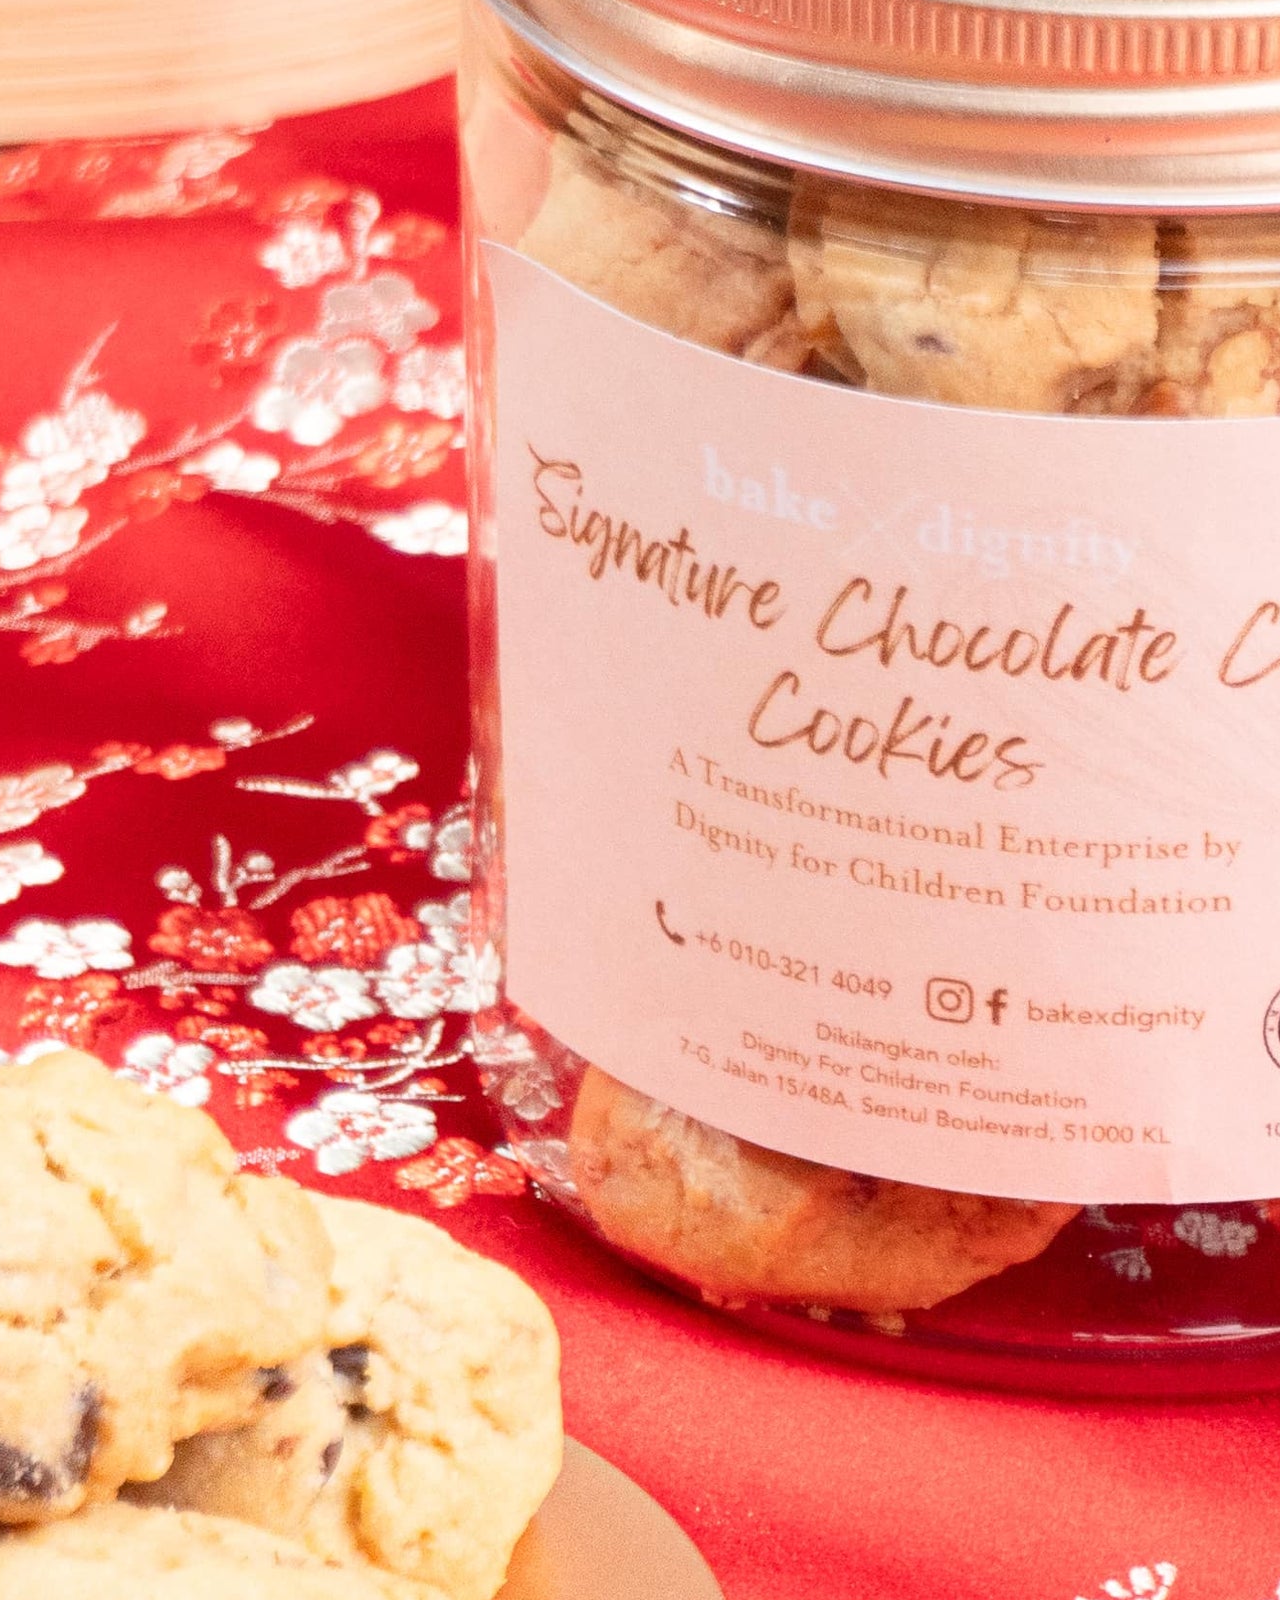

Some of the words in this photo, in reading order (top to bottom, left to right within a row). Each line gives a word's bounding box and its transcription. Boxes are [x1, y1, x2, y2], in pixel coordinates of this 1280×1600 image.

[702, 443, 838, 531] bake
[917, 502, 1140, 580] dignity
[526, 441, 788, 630] Signature
[816, 577, 1186, 692] Chocolate
[747, 670, 1046, 792] Cookies
[670, 747, 691, 777] A
[697, 755, 985, 850] Transformational
[999, 824, 1189, 869] Enterprise
[1202, 830, 1241, 867] by
[675, 801, 777, 869] Dignity
[791, 843, 838, 876] for
[849, 857, 1005, 907] Children
[1021, 882, 1232, 914] Foundation
[696, 931, 722, 953] +6
[729, 940, 820, 986] 010-321
[832, 970, 893, 999] 4049
[816, 1022, 939, 1061] Dikilangkan
[1027, 999, 1205, 1032] bakexdignity
[722, 1057, 769, 1086] Jalan
[862, 1097, 928, 1123] Sentul
[936, 1109, 1055, 1142] Boulevard,
[1063, 1122, 1134, 1144] 51000
[1142, 1126, 1171, 1144] KL
[742, 1030, 811, 1071] Dignity
[819, 1055, 852, 1077] For
[860, 1064, 950, 1096] Children
[959, 1081, 1087, 1109] Foundation
